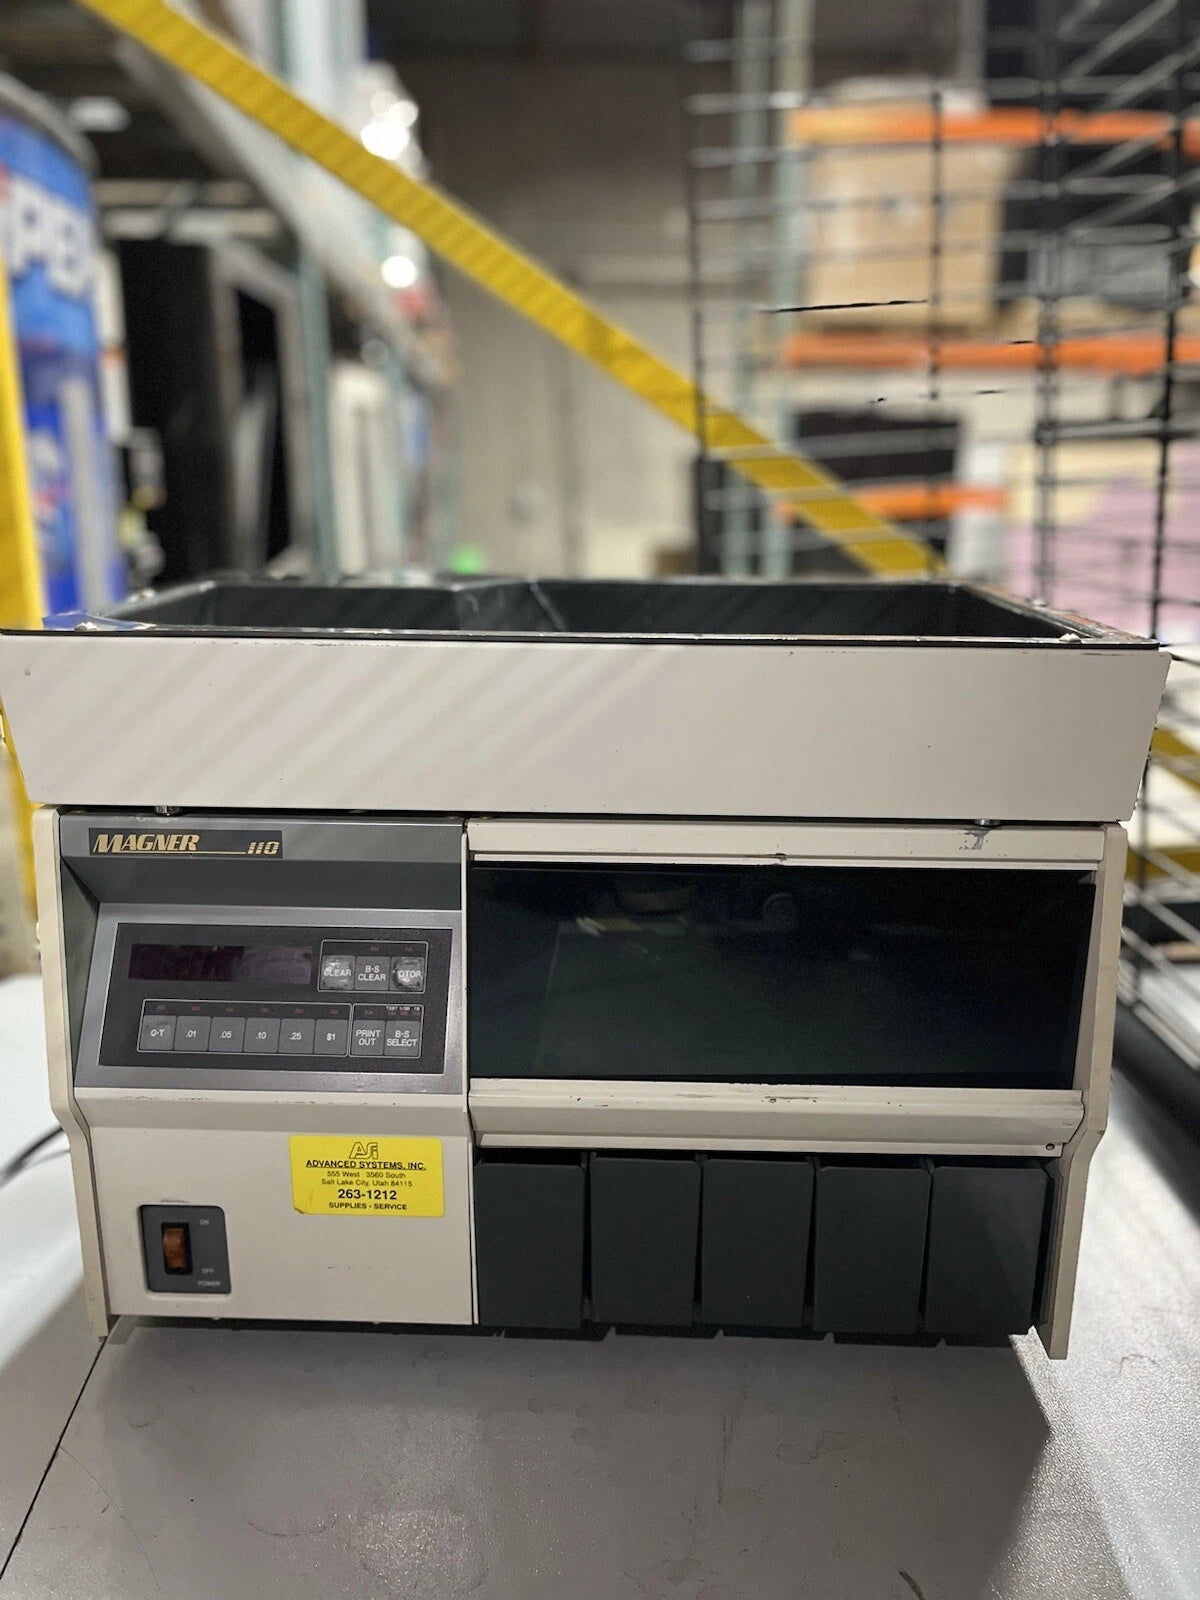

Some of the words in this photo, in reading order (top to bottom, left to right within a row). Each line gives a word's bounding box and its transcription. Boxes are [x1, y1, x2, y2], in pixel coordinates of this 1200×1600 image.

[93, 834, 200, 853] MAGNER
[247, 841, 280, 855] 110
[323, 968, 352, 977] CLEAR
[357, 973, 386, 981] CLEAR
[326, 1032, 336, 1041] $1
[356, 1029, 381, 1038] PRINT
[358, 1037, 377, 1046] OUT
[386, 1038, 419, 1047] SELECT
[306, 1160, 356, 1169] ADVANCED
[408, 1162, 427, 1171] INC.
[338, 1188, 398, 1200] 263-1212
